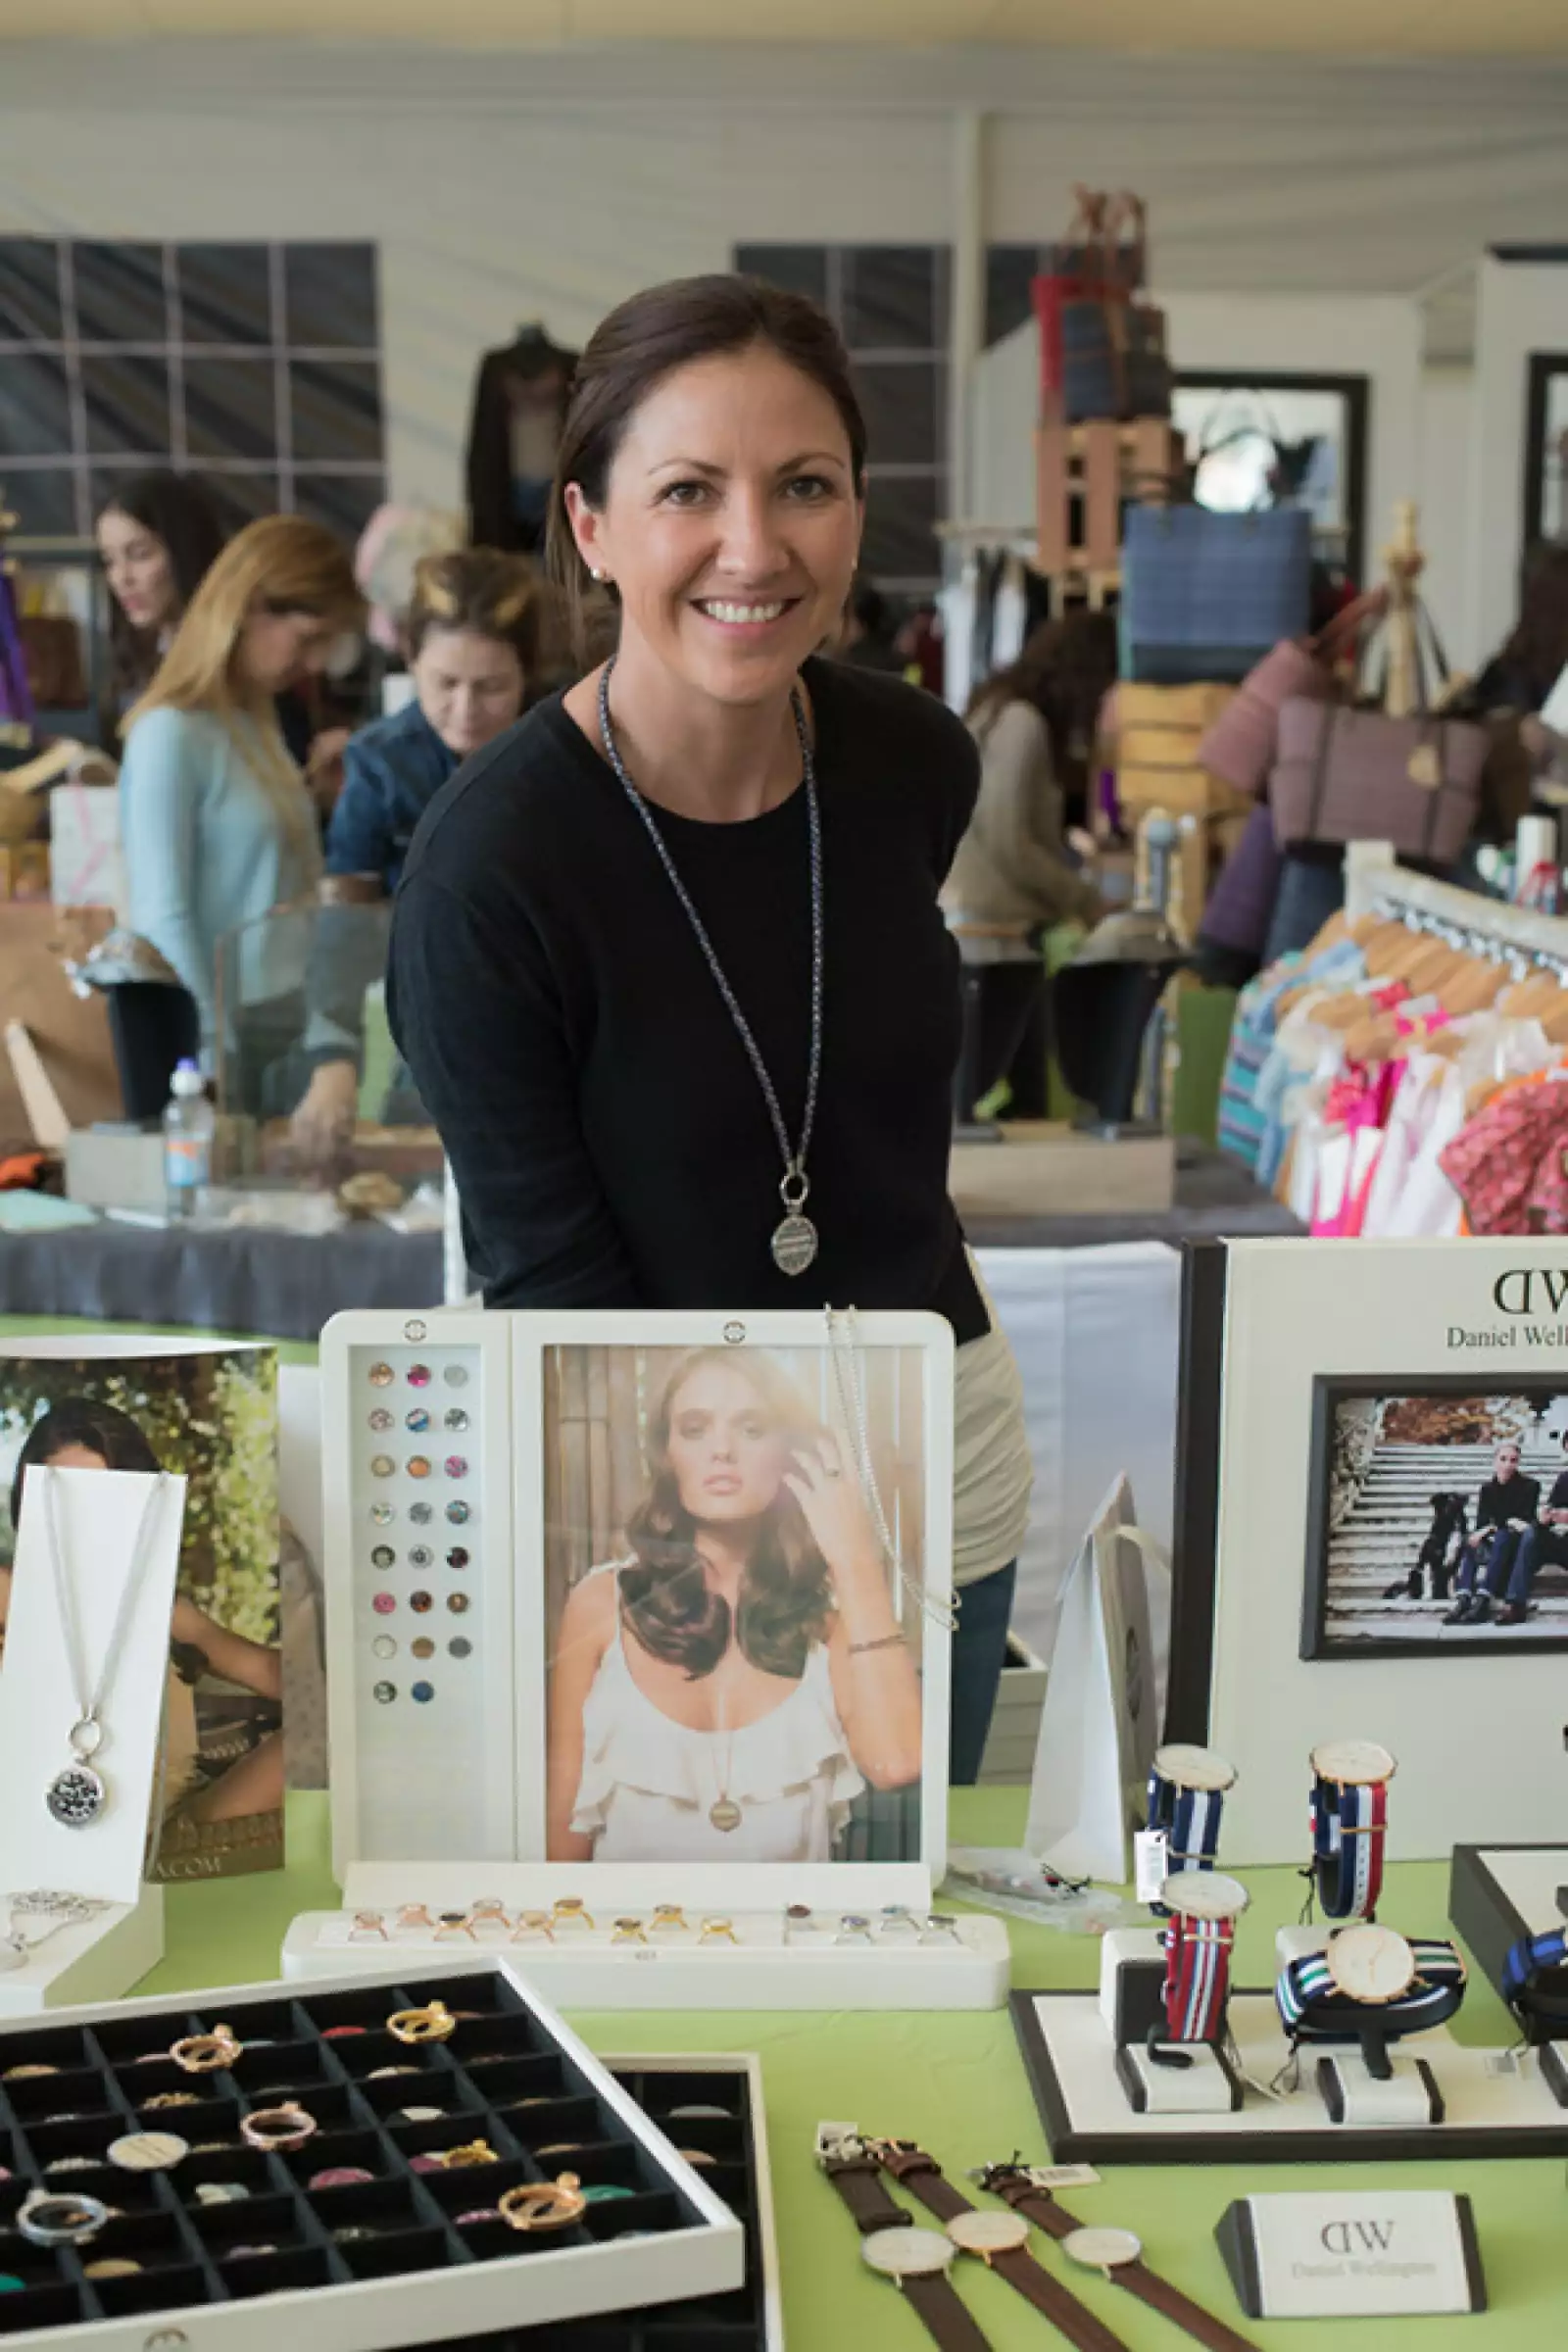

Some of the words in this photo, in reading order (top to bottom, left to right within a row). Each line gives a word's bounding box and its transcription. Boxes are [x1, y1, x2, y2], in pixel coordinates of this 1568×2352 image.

[1493, 1269, 1568, 1314] DW
[1446, 1325, 1516, 1348] Daniel
[1320, 2220, 1395, 2254] DW
